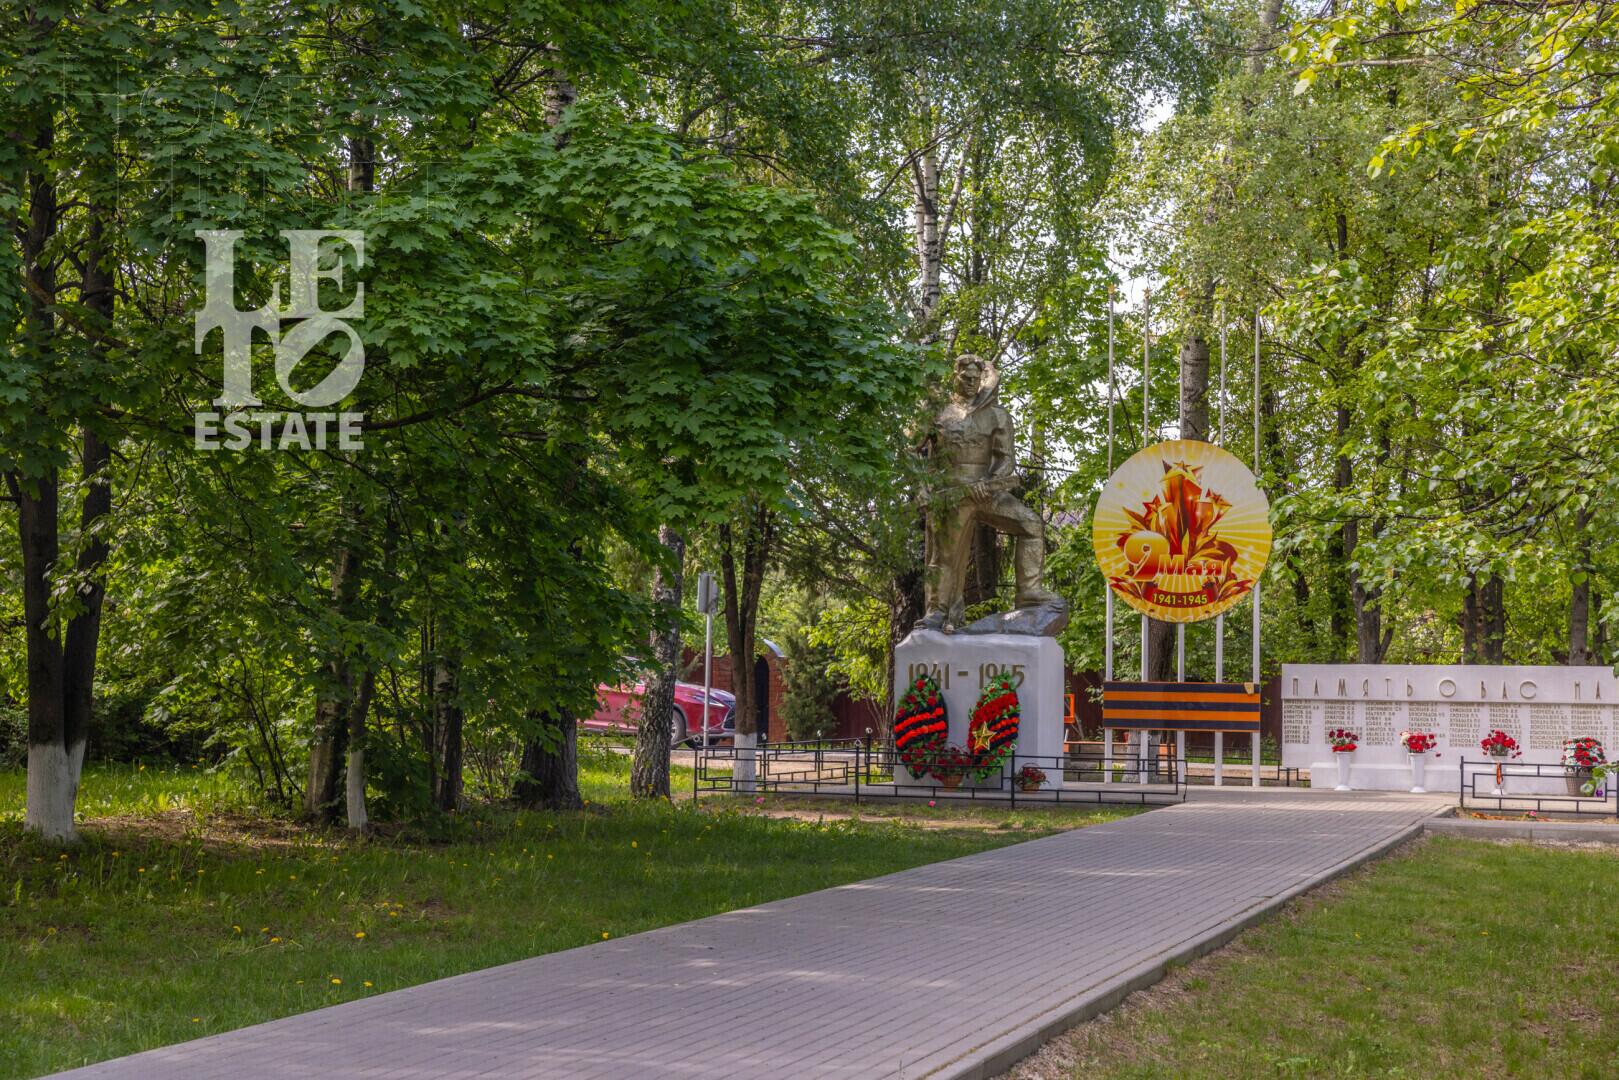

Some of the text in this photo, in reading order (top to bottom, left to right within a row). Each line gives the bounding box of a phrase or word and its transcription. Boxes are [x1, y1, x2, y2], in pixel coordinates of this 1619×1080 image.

[1124, 530, 1170, 581] 9
[1152, 593, 1208, 605] 1941-1945
[1292, 677, 1414, 697] ПАМЯТЬ
[1439, 679, 1456, 698] О
[1480, 680, 1538, 700] ВАС
